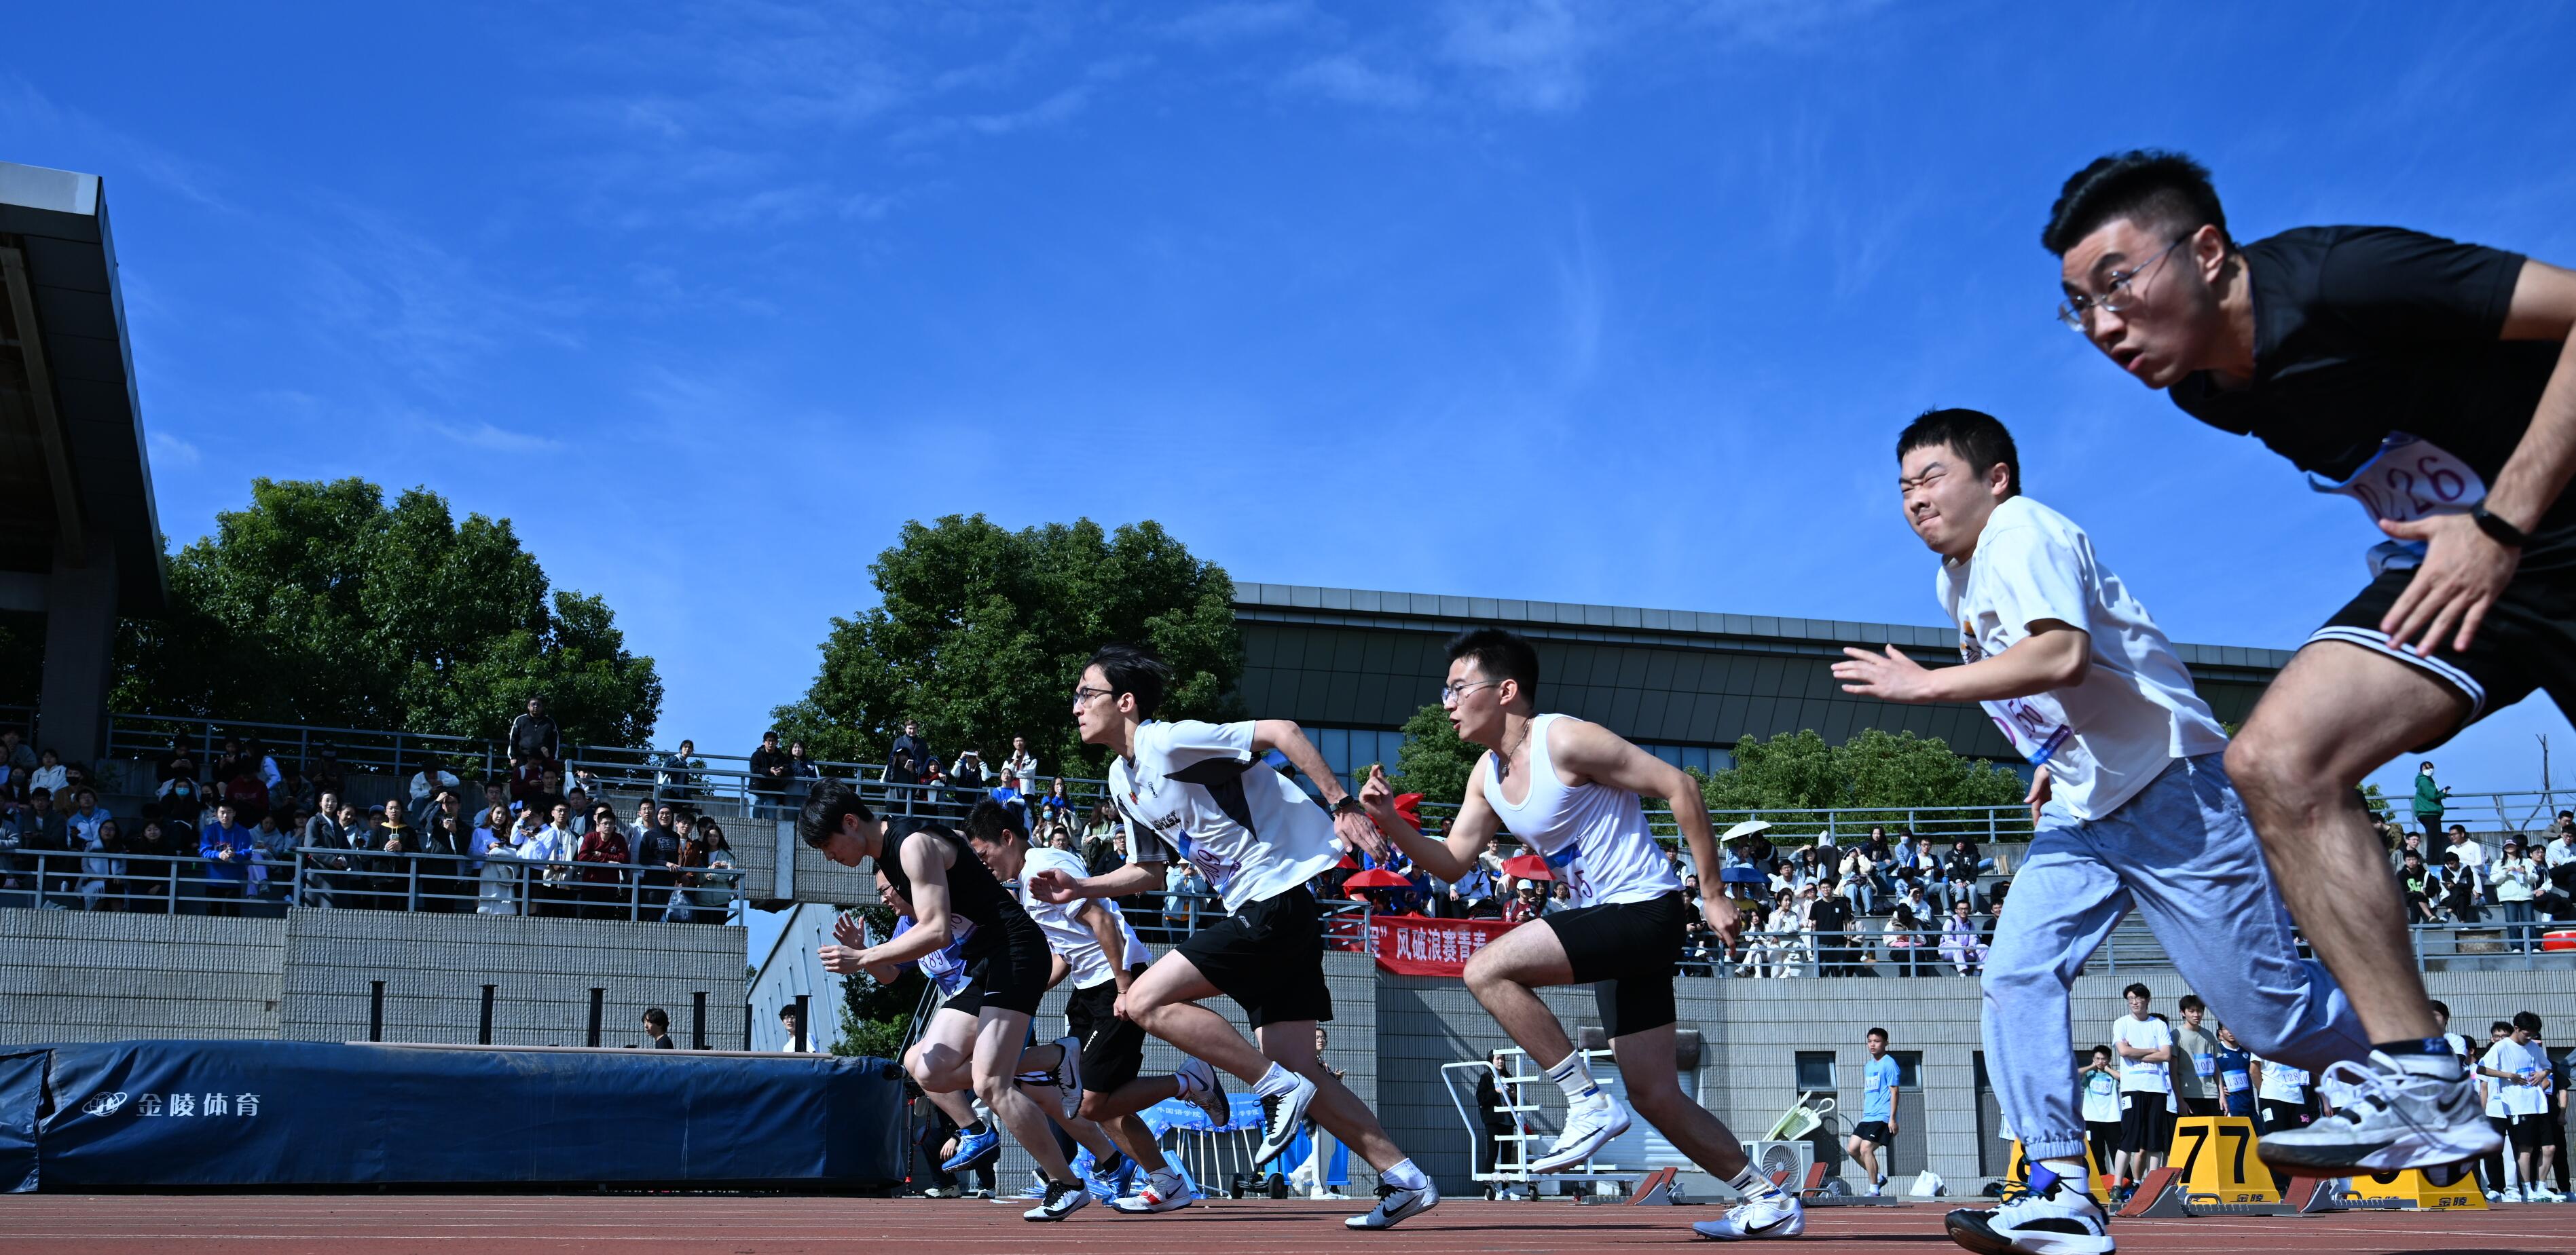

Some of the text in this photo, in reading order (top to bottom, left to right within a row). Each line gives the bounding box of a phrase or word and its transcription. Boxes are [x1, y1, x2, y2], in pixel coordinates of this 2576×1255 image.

[136, 1092, 261, 1117] 金陵体育
[1156, 1106, 1202, 1119] 外国语学院
[2237, 1194, 2264, 1202] 金陵
[2438, 1197, 2467, 1207] 金陵
